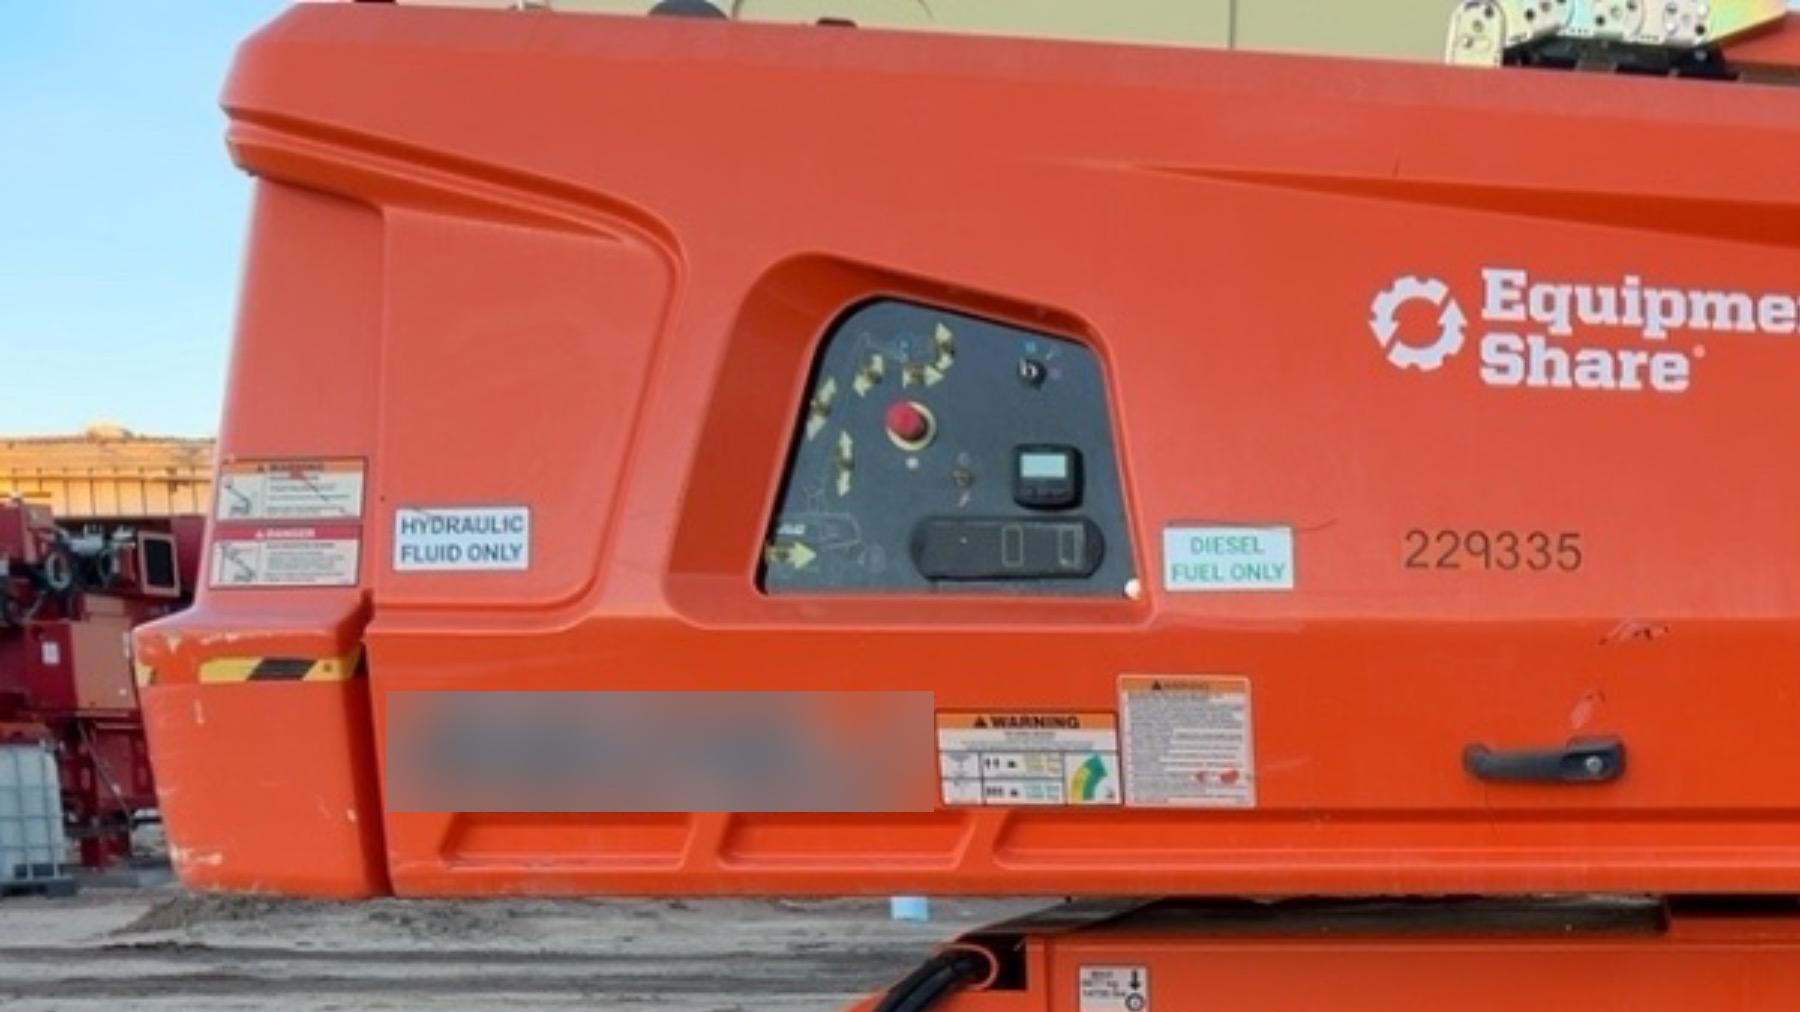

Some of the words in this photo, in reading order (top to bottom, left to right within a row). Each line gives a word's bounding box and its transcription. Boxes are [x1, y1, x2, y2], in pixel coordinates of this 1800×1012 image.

[1480, 332, 1691, 392] Share
[401, 515, 524, 535] HYDRAULIC
[401, 543, 462, 563] FLUID
[467, 543, 522, 562] ONLY
[1190, 536, 1265, 555] DIESEL
[1404, 529, 1584, 572] 229335
[1171, 563, 1224, 582] FUEL
[1230, 563, 1285, 582] ONLY
[990, 716, 1081, 729] WARNING
